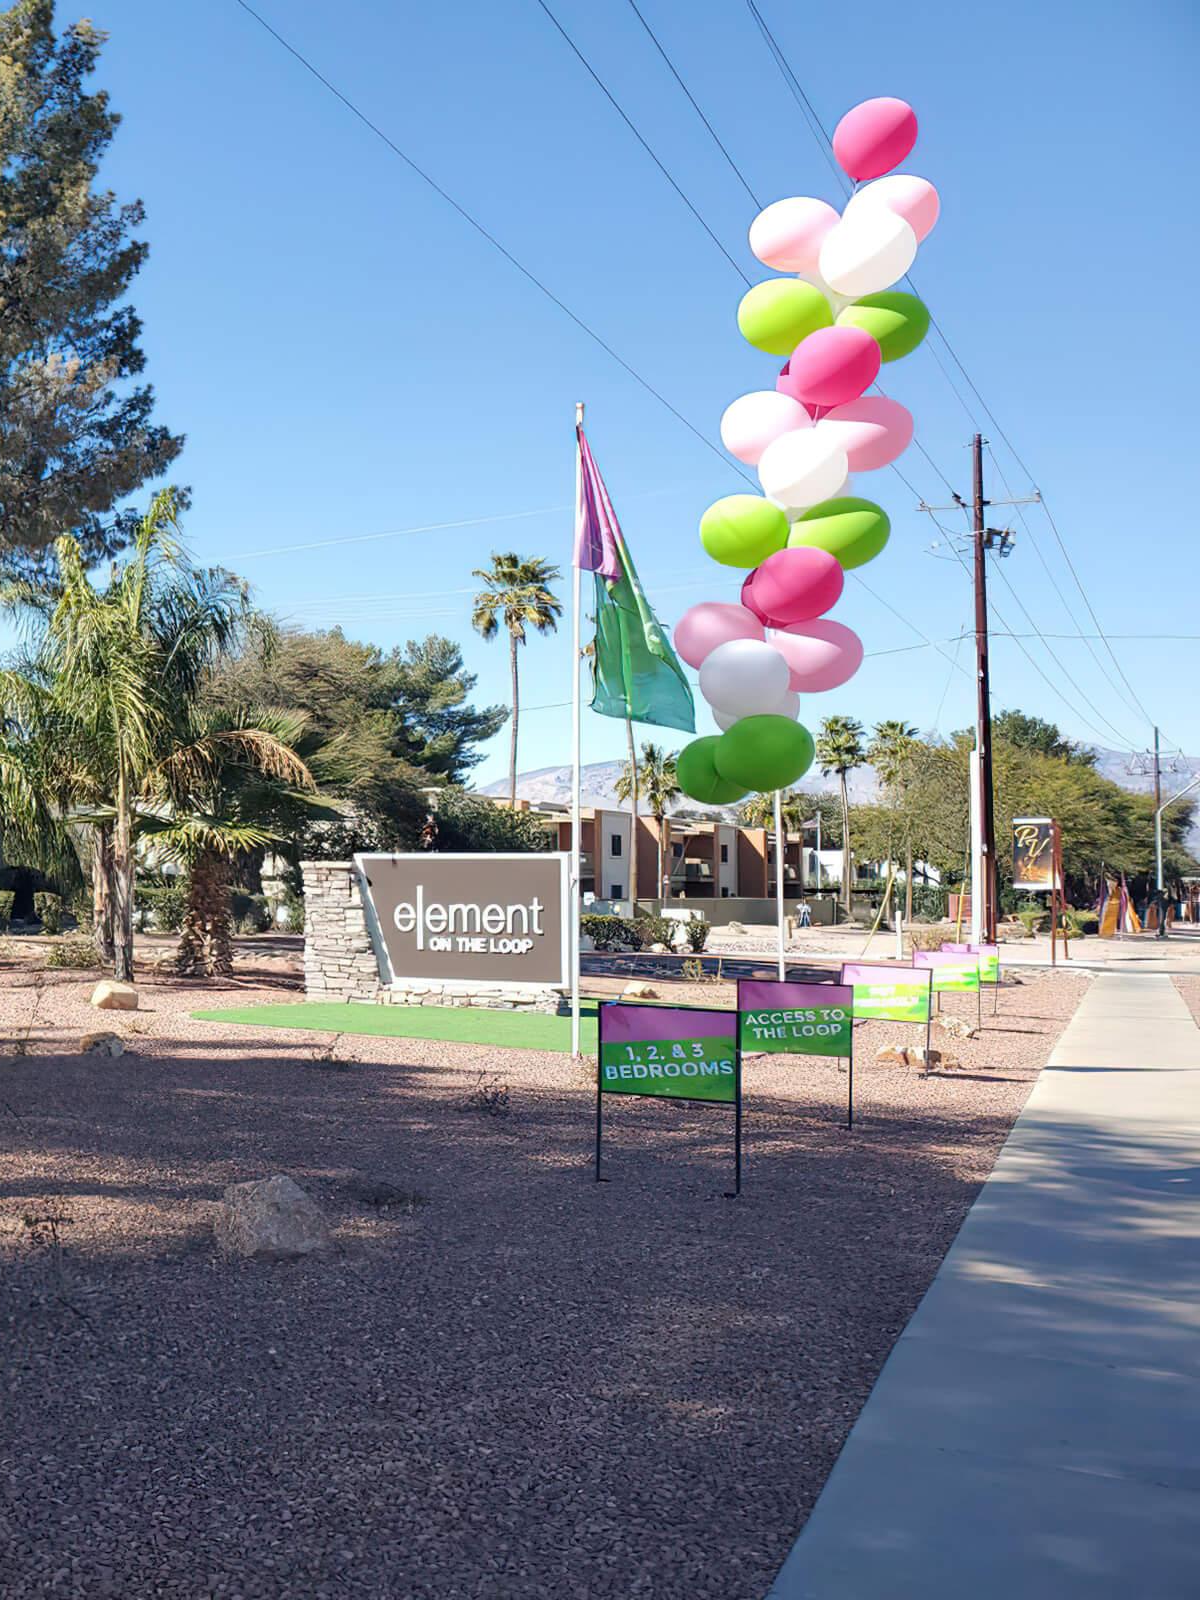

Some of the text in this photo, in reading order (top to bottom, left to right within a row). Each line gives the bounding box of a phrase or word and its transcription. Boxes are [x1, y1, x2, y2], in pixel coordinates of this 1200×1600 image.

[393, 885, 544, 950] element
[429, 937, 533, 954] ON THE LOOP
[745, 1009, 845, 1025] ACCESS TO
[752, 1024, 842, 1039] THE LOOP
[625, 1046, 641, 1062] 1,
[672, 1044, 686, 1058] &
[692, 1043, 704, 1057] 3
[605, 1060, 733, 1080] BEDROOMS
